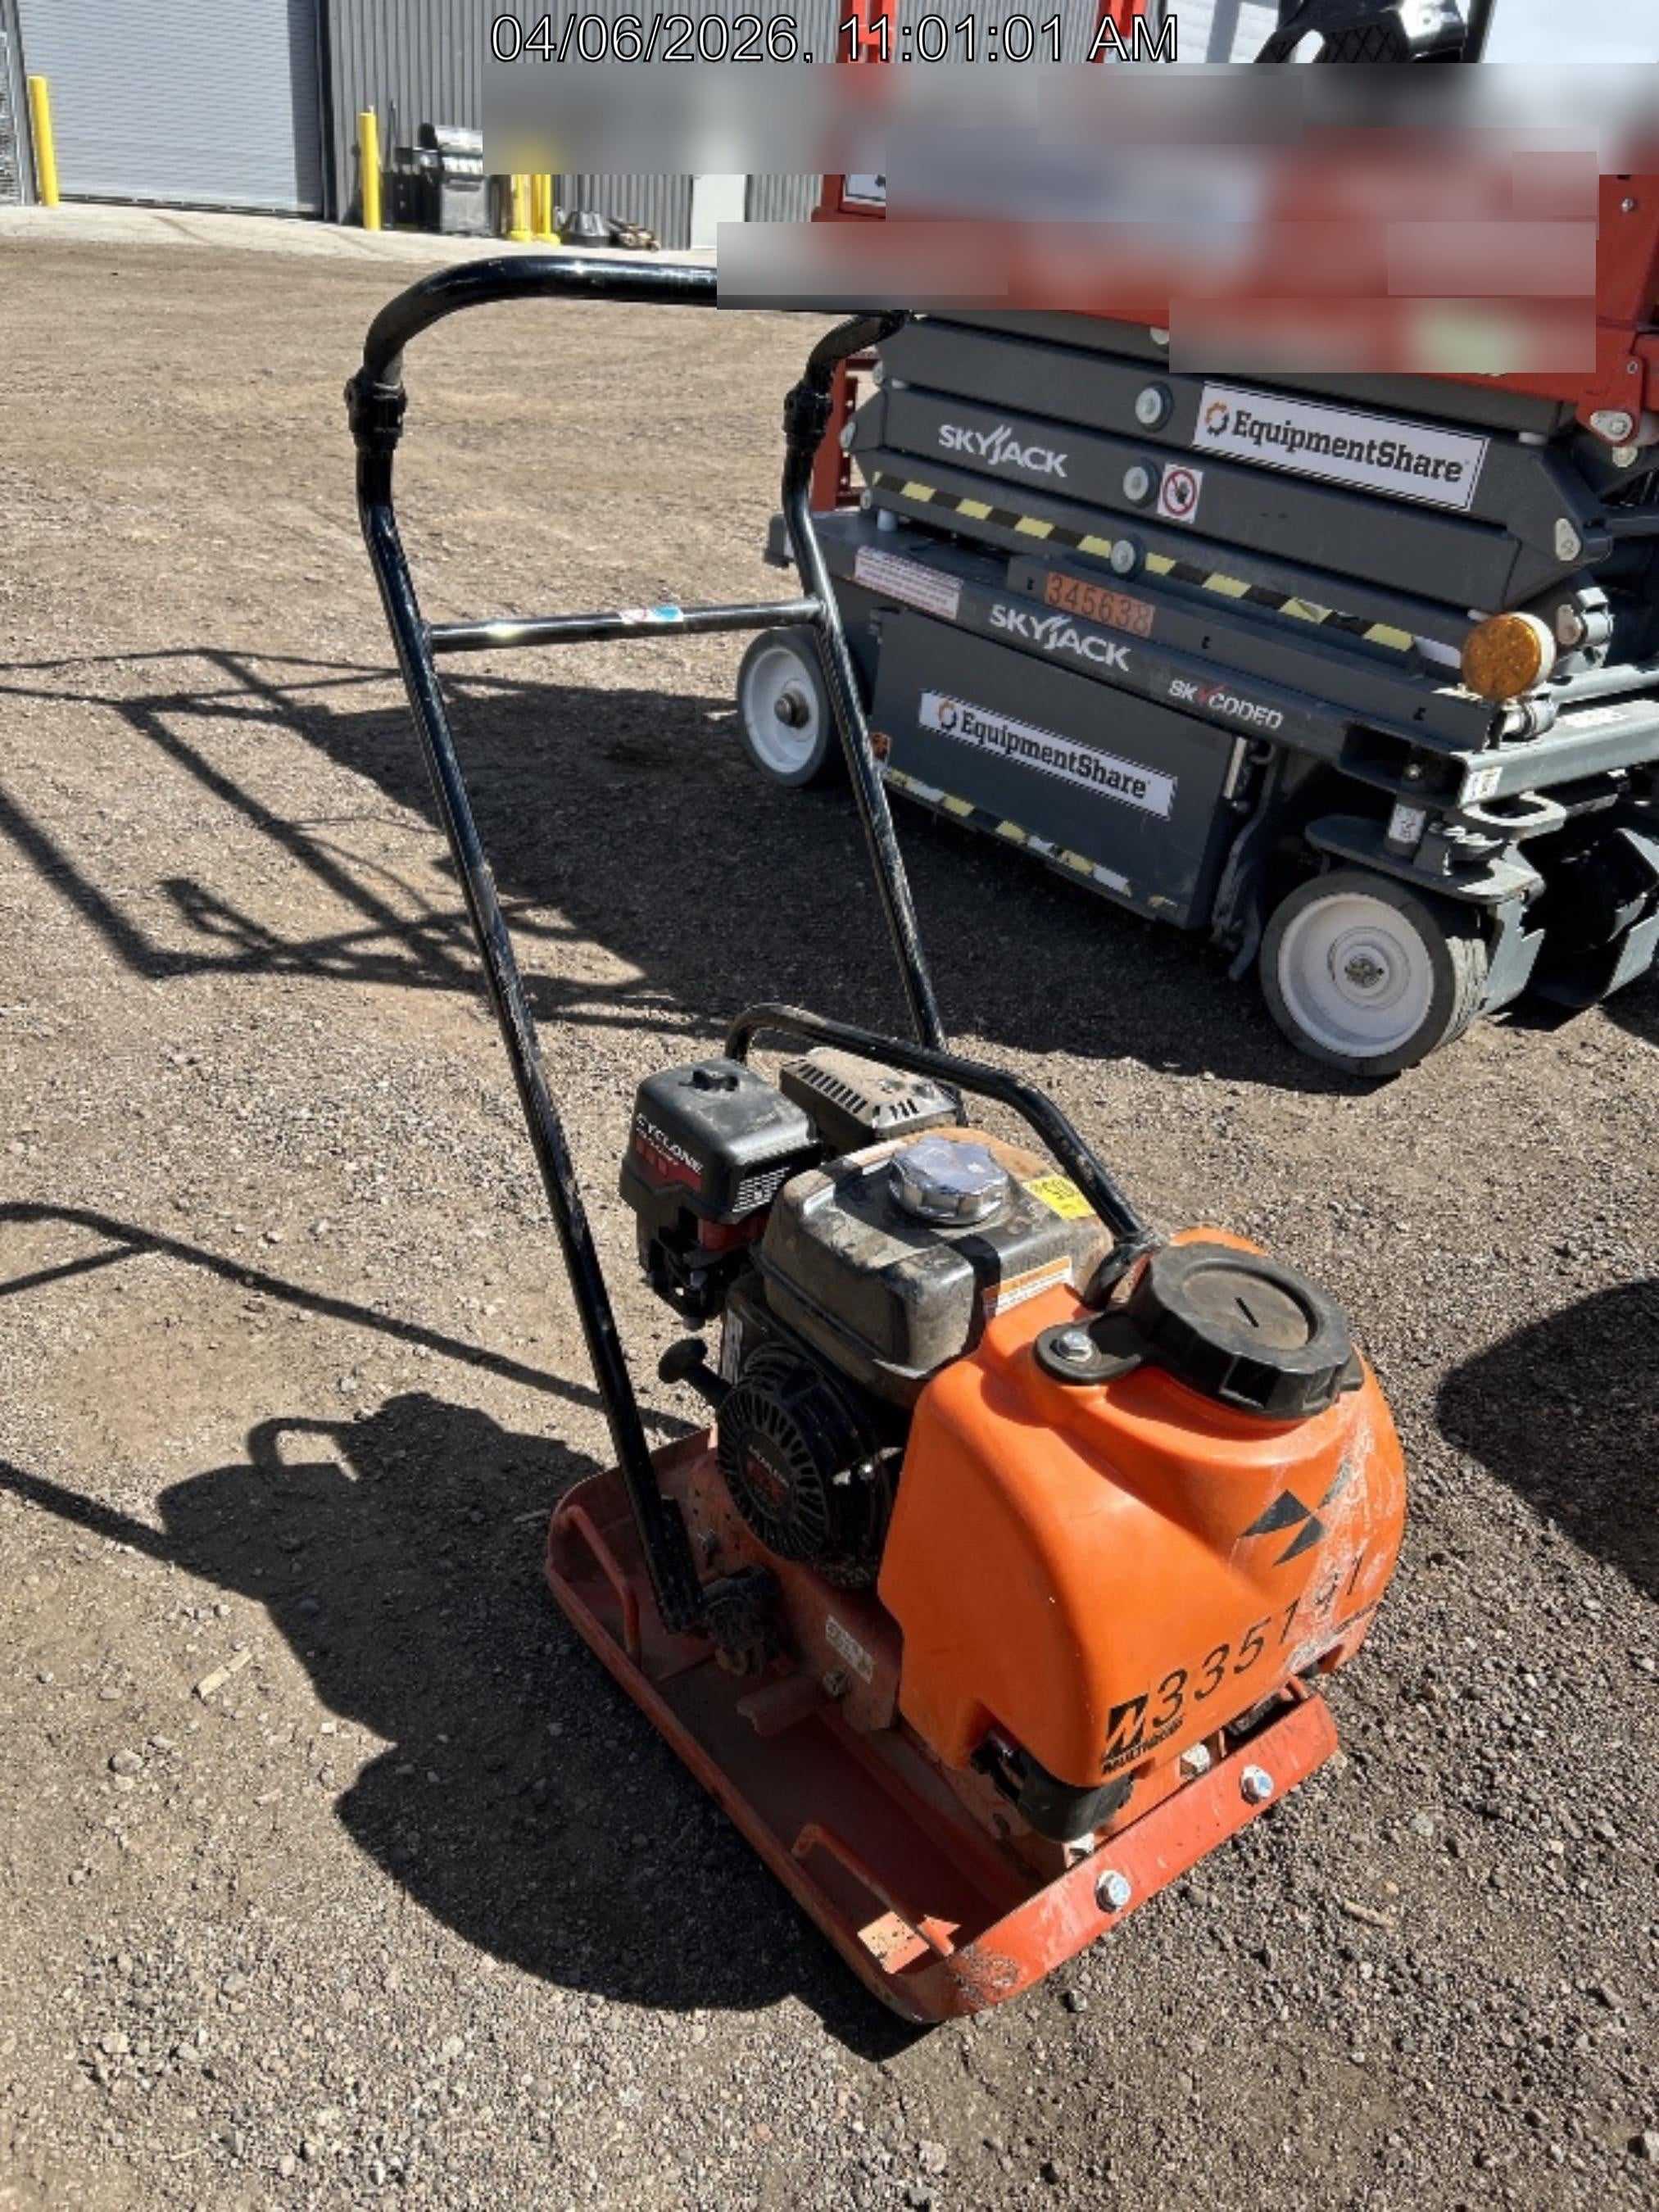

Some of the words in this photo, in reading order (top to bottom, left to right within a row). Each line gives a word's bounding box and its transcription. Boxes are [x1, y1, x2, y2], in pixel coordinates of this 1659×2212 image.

[939, 424, 1067, 478] SKYJACK
[1231, 410, 1463, 483] EquipmentShare
[990, 603, 1131, 672] SKYJACK
[1048, 574, 1148, 634] 345638
[960, 711, 1146, 800] EquipmentShare
